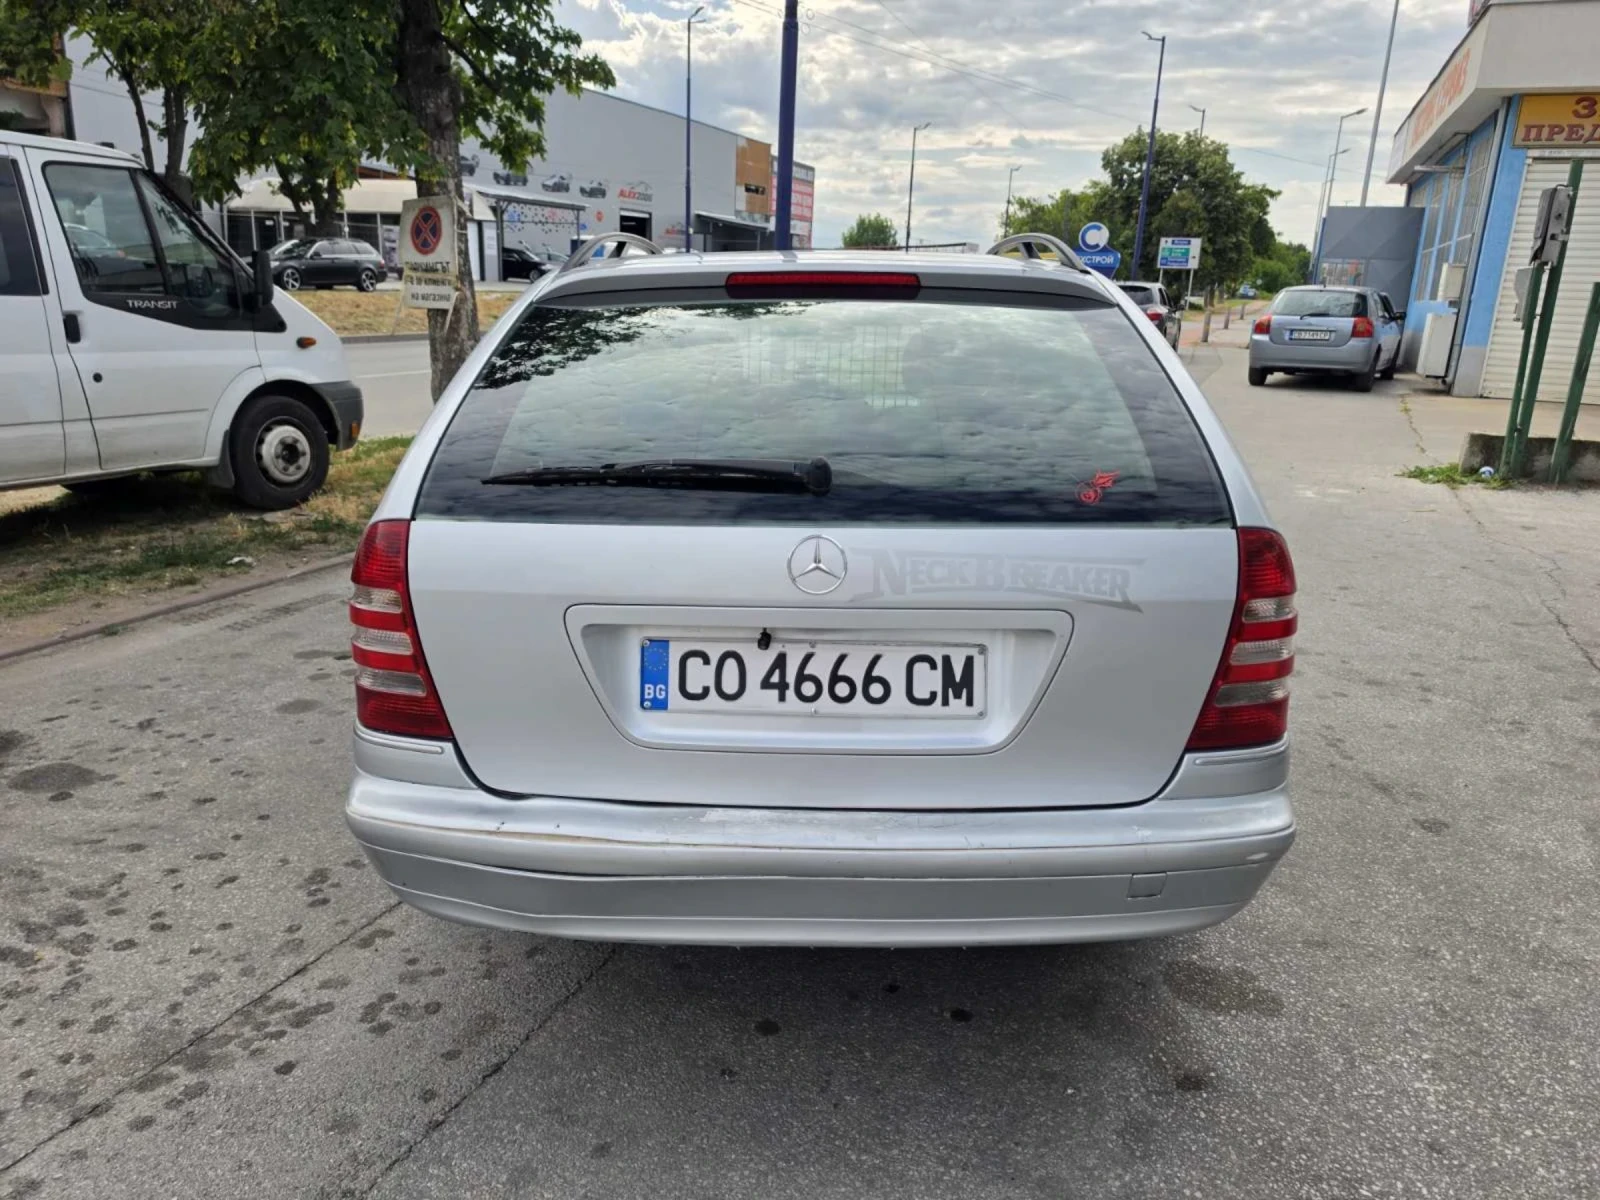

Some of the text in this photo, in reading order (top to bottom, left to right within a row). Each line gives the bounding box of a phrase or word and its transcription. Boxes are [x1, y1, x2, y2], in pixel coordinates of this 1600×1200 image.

[126, 299, 177, 309] TRANSIT
[678, 650, 974, 707] CO 4666 CM
[644, 684, 666, 699] BG
